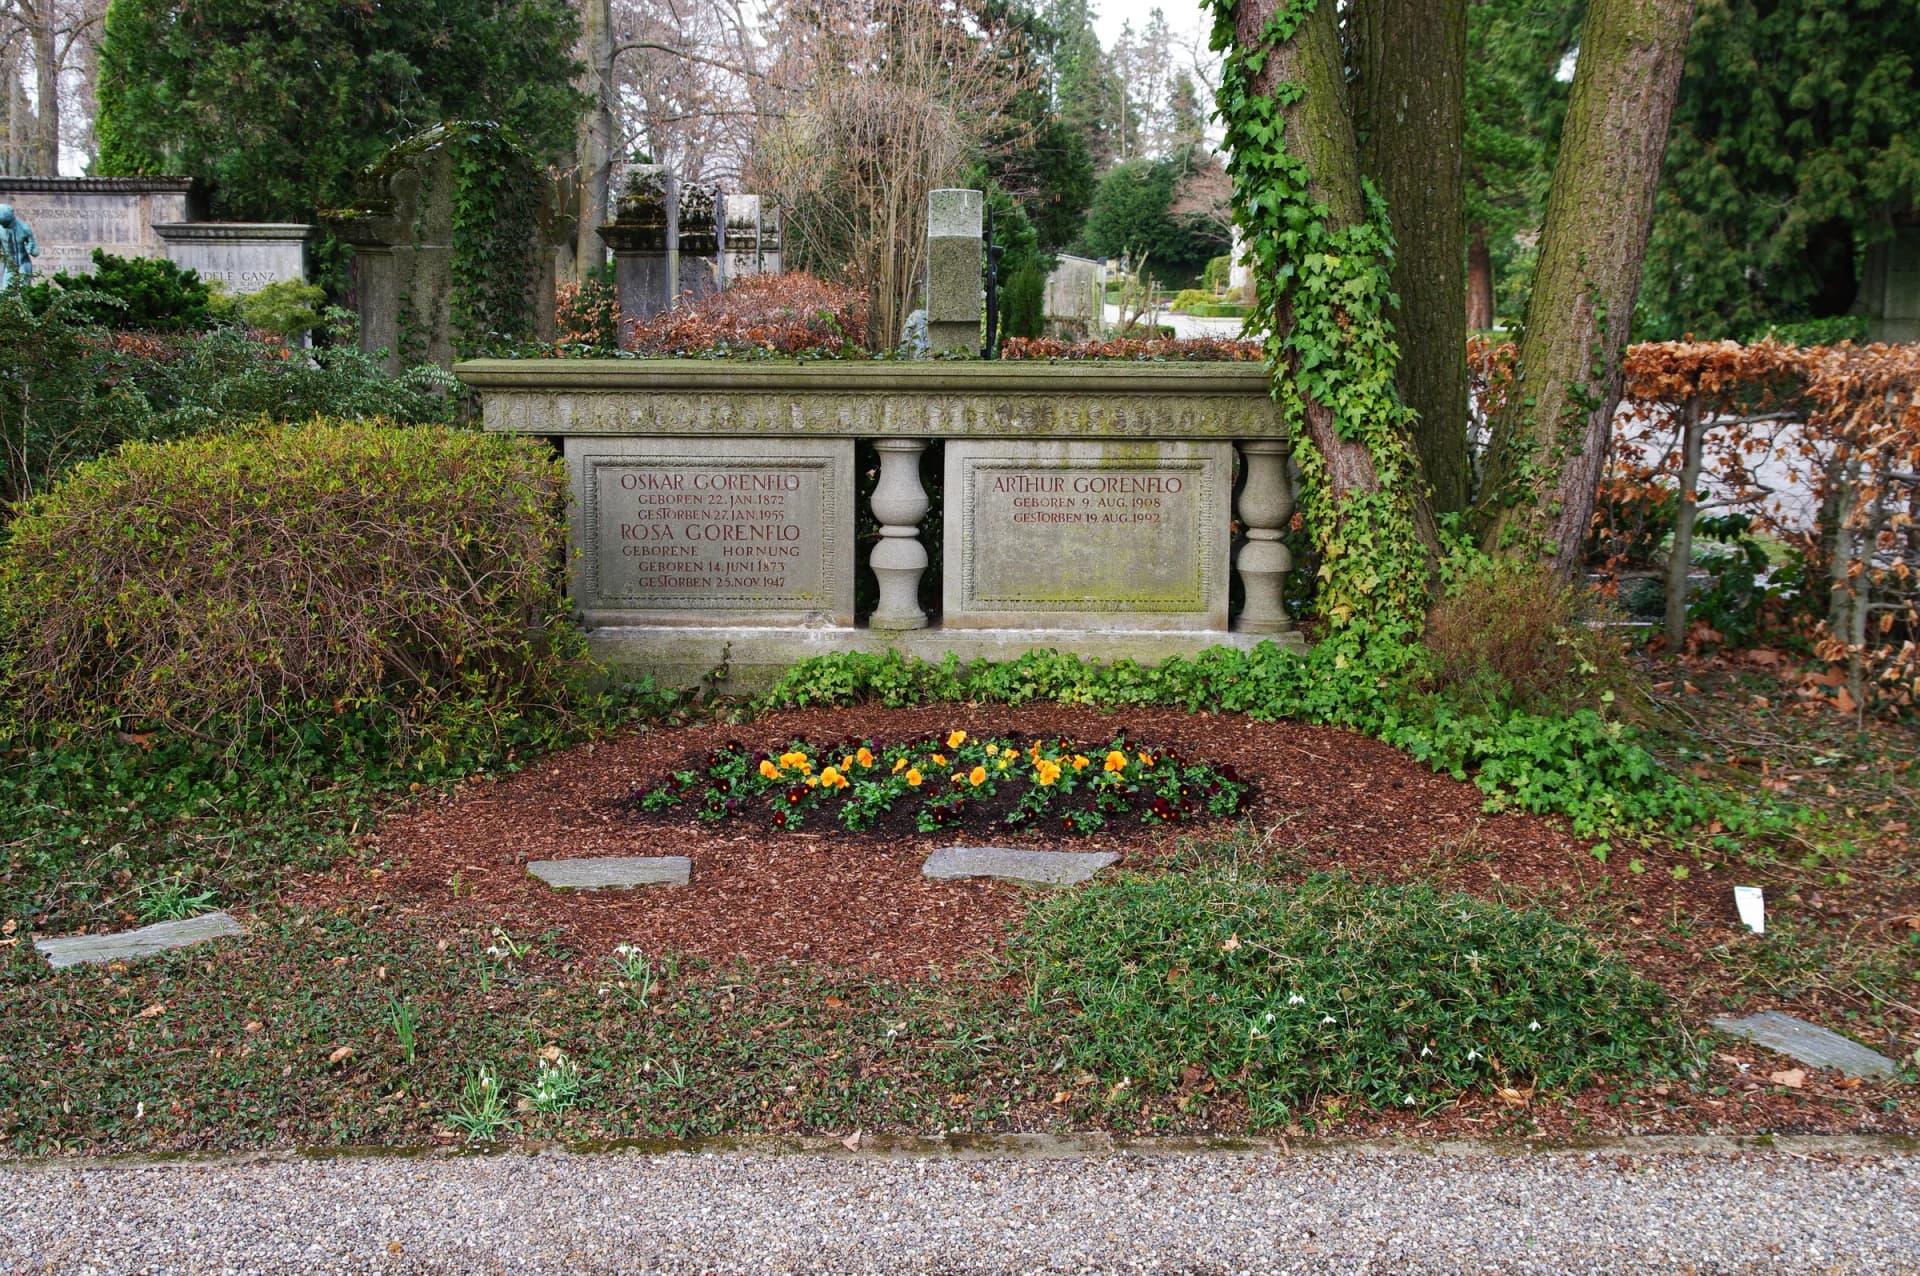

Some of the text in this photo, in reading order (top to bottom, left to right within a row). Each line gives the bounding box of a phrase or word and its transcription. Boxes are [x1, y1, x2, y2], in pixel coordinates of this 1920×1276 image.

[241, 271, 274, 281] GANZ
[621, 473, 800, 491] OSKAR GORENFLO
[992, 475, 1182, 493] ARTHUR GORENFLO
[638, 494, 703, 505] GEBOREN
[758, 494, 785, 505] 1872
[1013, 497, 1075, 508] GEBOREN
[1132, 497, 1161, 509] 1908
[638, 507, 711, 520] GESTORBEN
[760, 510, 785, 521] 1955
[1013, 511, 1082, 523] GESTORBEN
[1132, 513, 1161, 524] 1992
[621, 524, 800, 541] ROSA GORENFLO
[622, 545, 800, 557] GEBORENE HORNUNG
[638, 561, 703, 572] GEBOREN
[725, 561, 754, 576] JUNI
[758, 559, 785, 572] 1873
[638, 575, 711, 588] GESTORBEN
